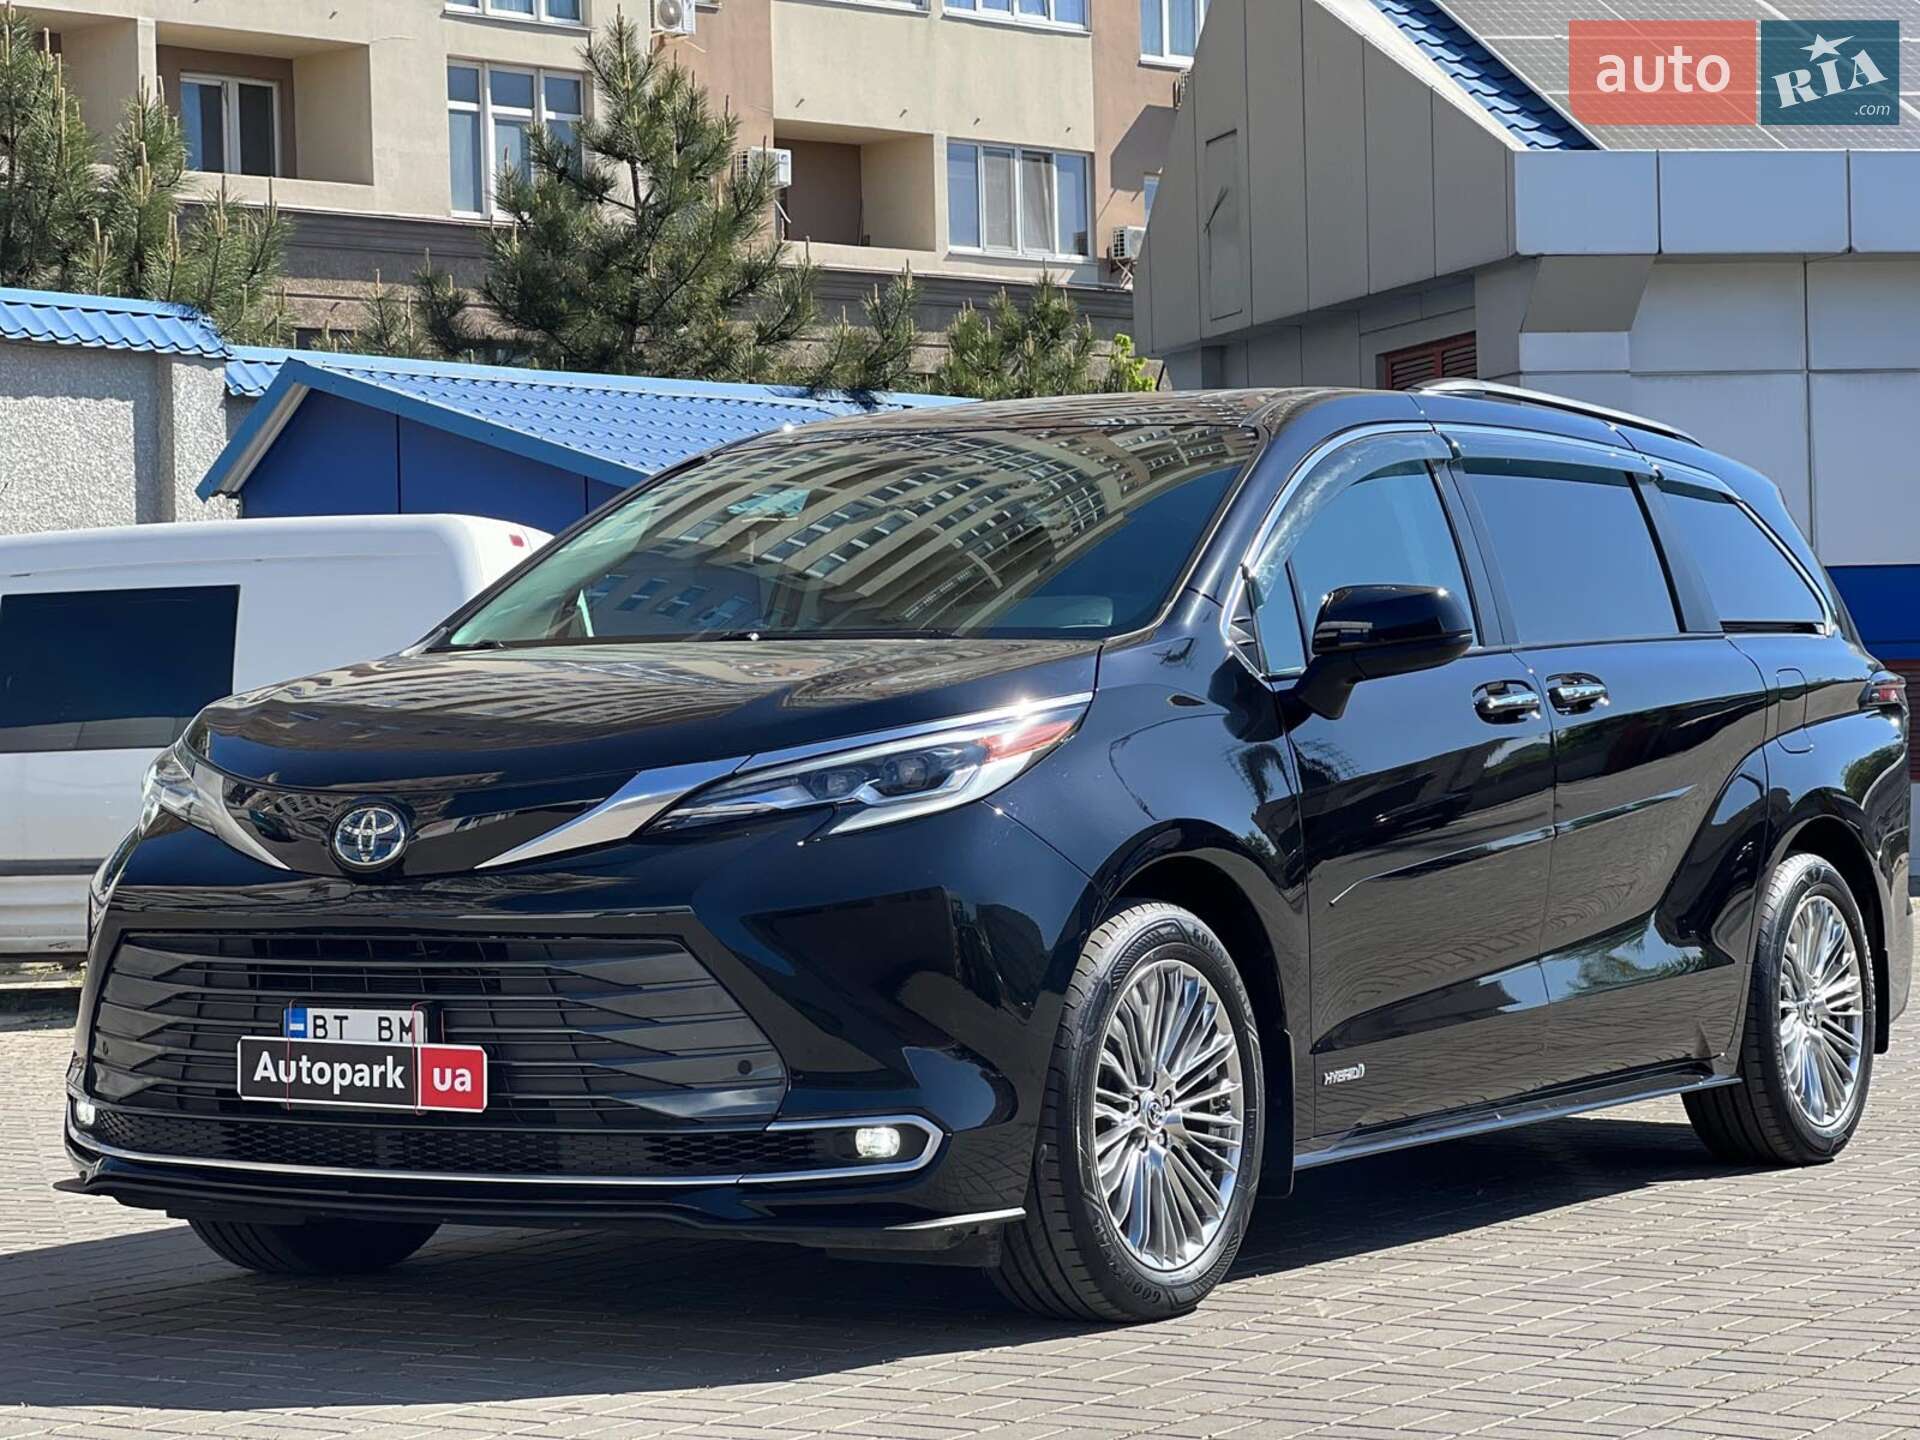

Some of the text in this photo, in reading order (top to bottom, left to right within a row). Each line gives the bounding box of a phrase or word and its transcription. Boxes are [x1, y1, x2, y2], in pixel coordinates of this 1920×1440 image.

[313, 1014, 416, 1042] BT BM
[253, 1051, 473, 1095] Autopark ua
